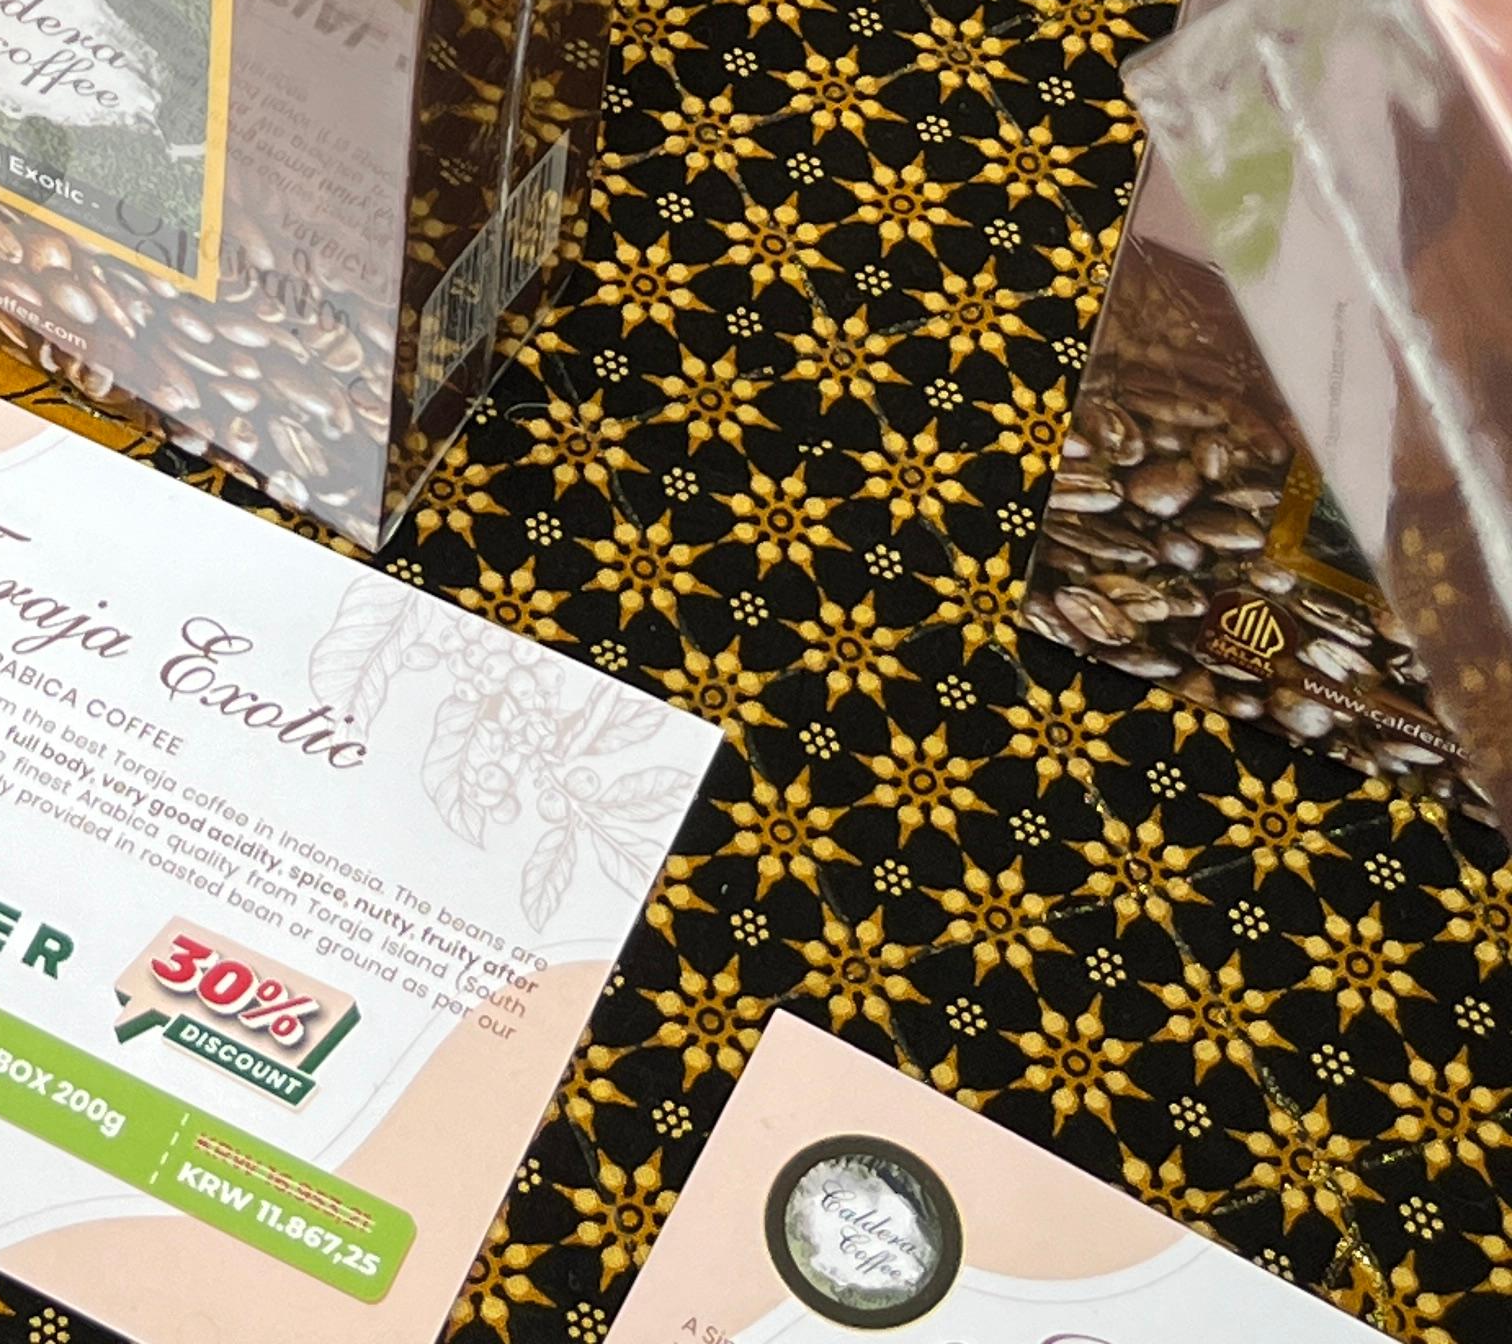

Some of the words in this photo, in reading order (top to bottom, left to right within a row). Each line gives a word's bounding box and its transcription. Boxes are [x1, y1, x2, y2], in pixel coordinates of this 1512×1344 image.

[9, 156, 85, 205] Exotic
[86, 698, 183, 757] COFFEE
[160, 616, 367, 770] Exotic
[3, 723, 41, 753] full
[38, 740, 96, 785] body,
[101, 772, 149, 808] very
[146, 797, 208, 834] good
[206, 824, 283, 877] acidity,
[287, 864, 349, 909] spice,
[352, 896, 415, 941] nutty,
[419, 925, 482, 971] fruity
[481, 959, 540, 994] after
[150, 934, 320, 1045] 30%
[179, 1023, 303, 1097] DISCOUNT
[53, 1078, 127, 1138] 200g
[177, 1162, 252, 1210] KRW
[255, 1199, 381, 1277] 11.867,25
[820, 1178, 918, 1255] Caldera
[837, 1224, 901, 1280] Coffee
